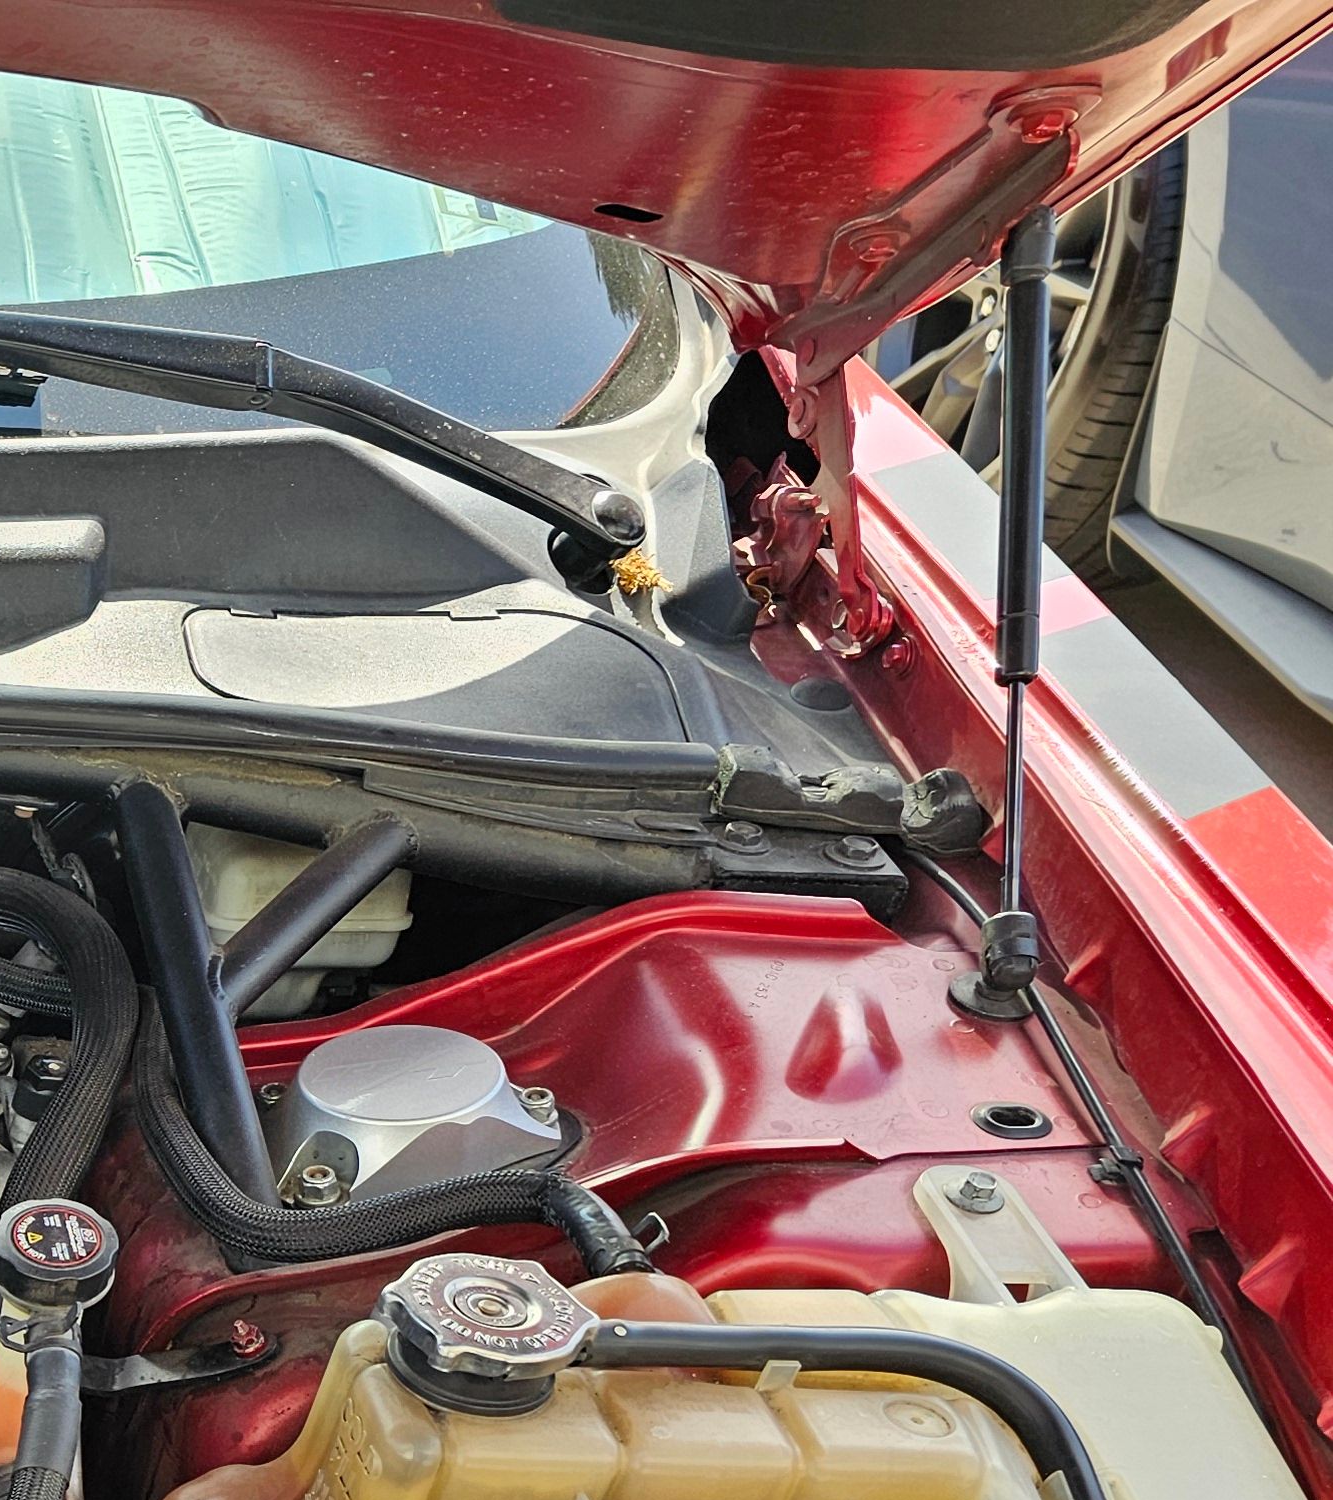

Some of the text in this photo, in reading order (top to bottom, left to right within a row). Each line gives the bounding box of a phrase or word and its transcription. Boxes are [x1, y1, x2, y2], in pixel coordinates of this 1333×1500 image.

[440, 1319, 472, 1337] DO
[474, 1331, 519, 1350] NOT
[523, 1322, 571, 1349] OPEN
